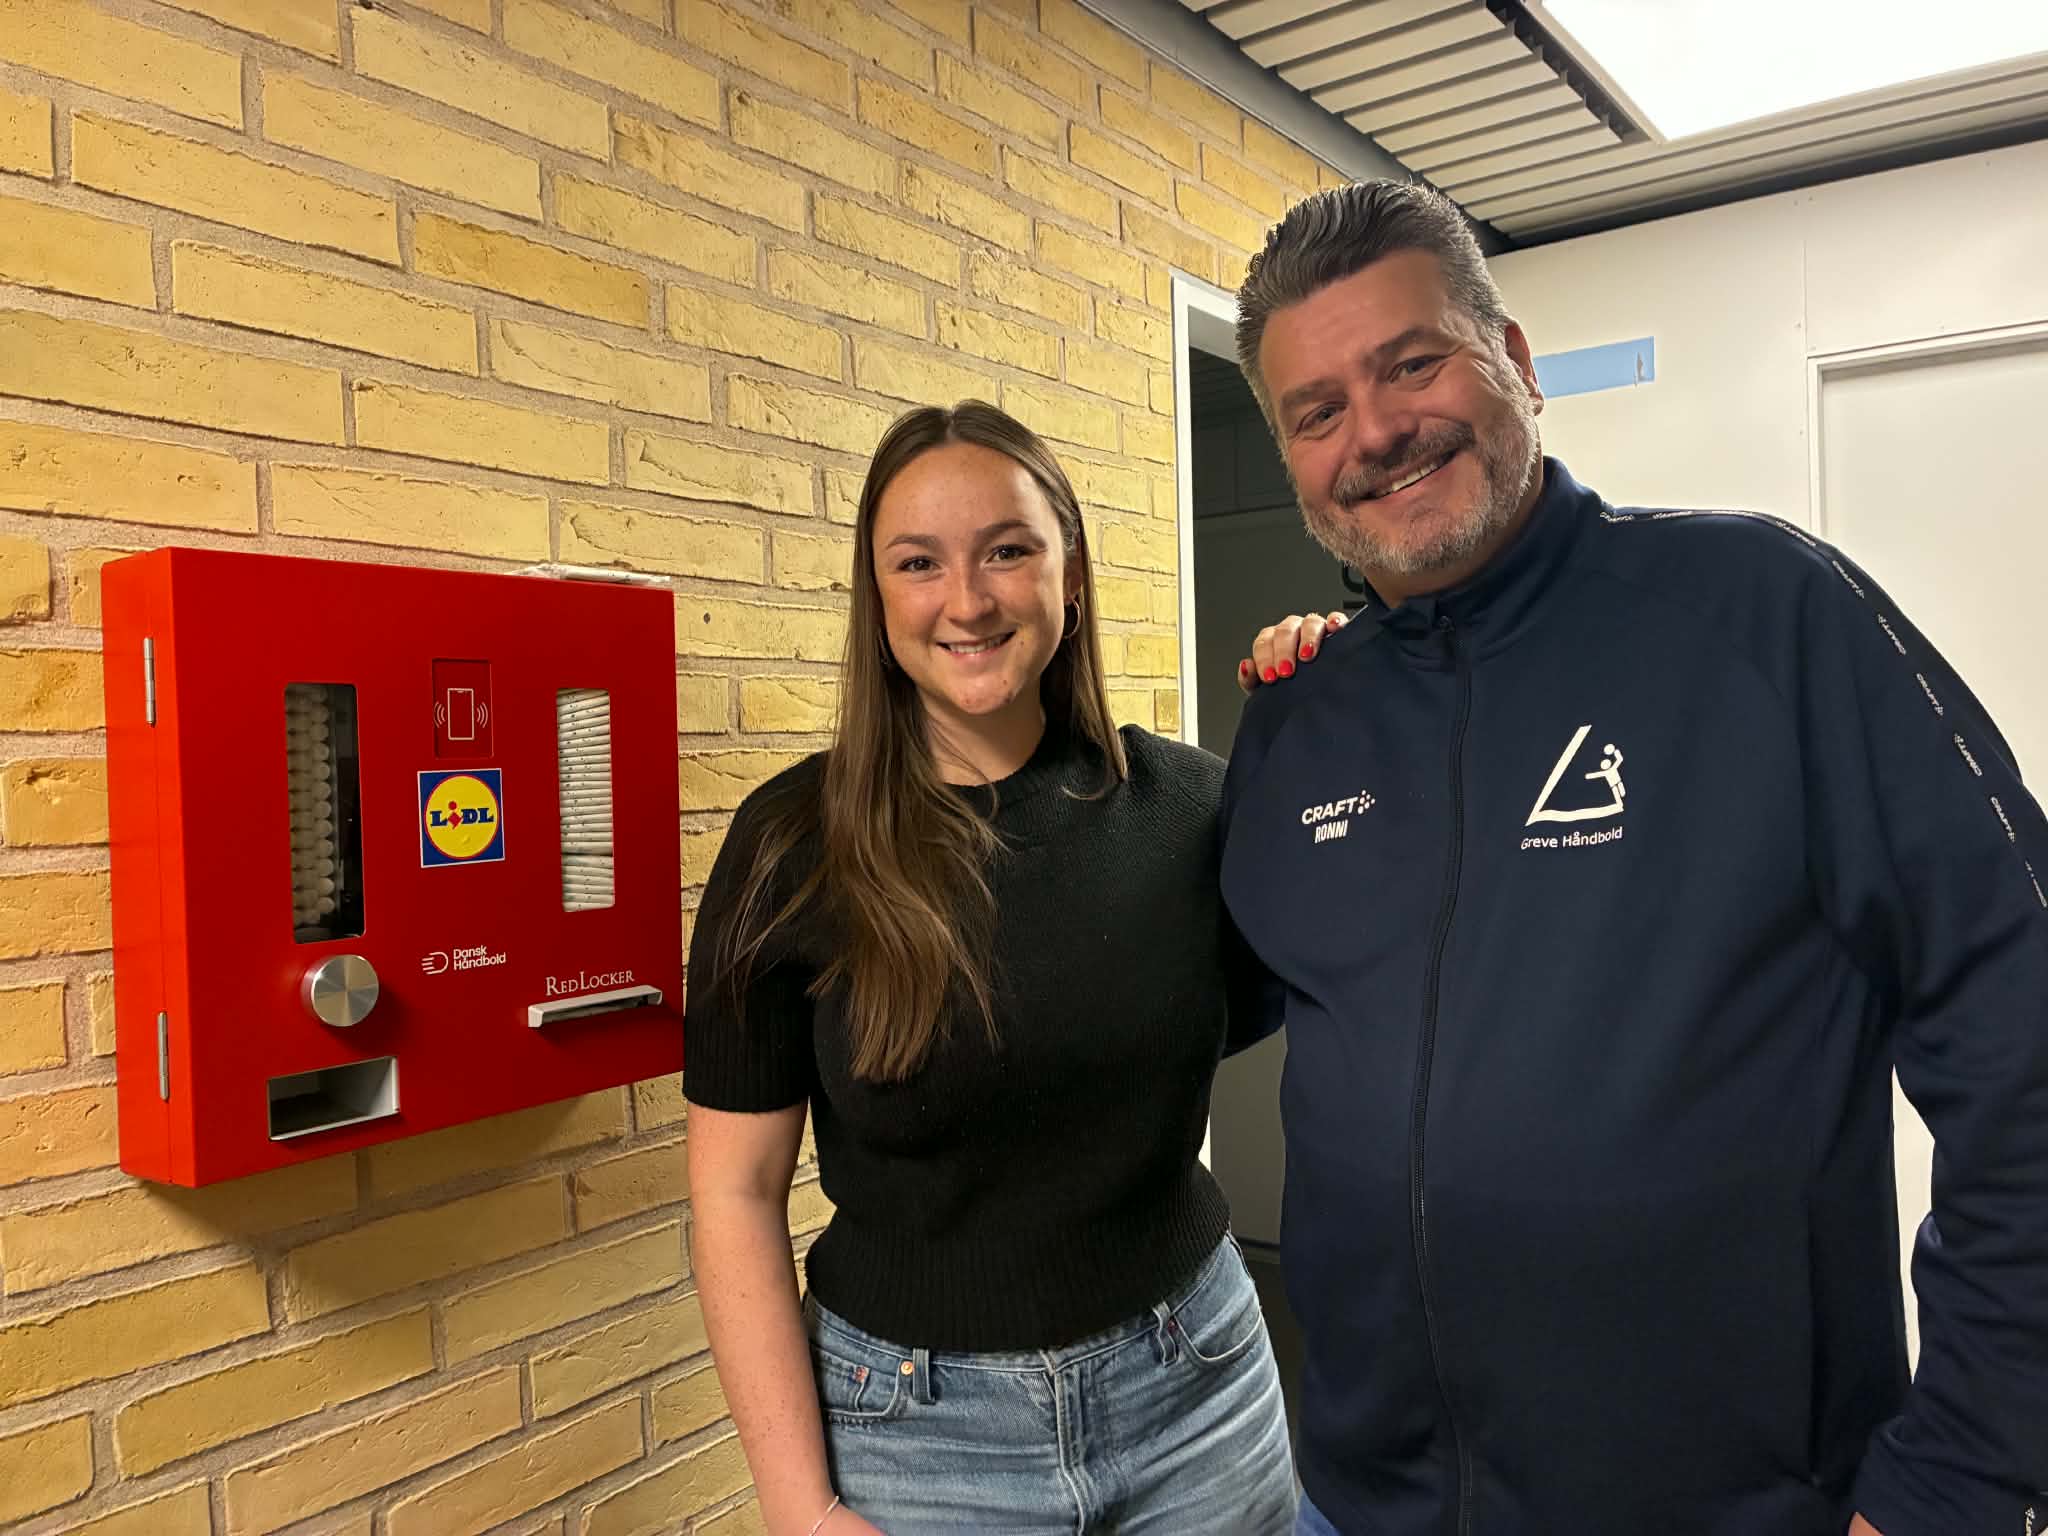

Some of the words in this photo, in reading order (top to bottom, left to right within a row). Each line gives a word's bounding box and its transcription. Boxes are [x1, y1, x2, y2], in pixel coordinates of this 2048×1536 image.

[1301, 796, 1359, 825] CRAFT
[1314, 818, 1349, 844] RONNI
[1520, 837, 1559, 850] Greve
[1562, 825, 1624, 848] Håndbold
[453, 944, 488, 960] Dansk
[453, 951, 507, 971] Håndbold
